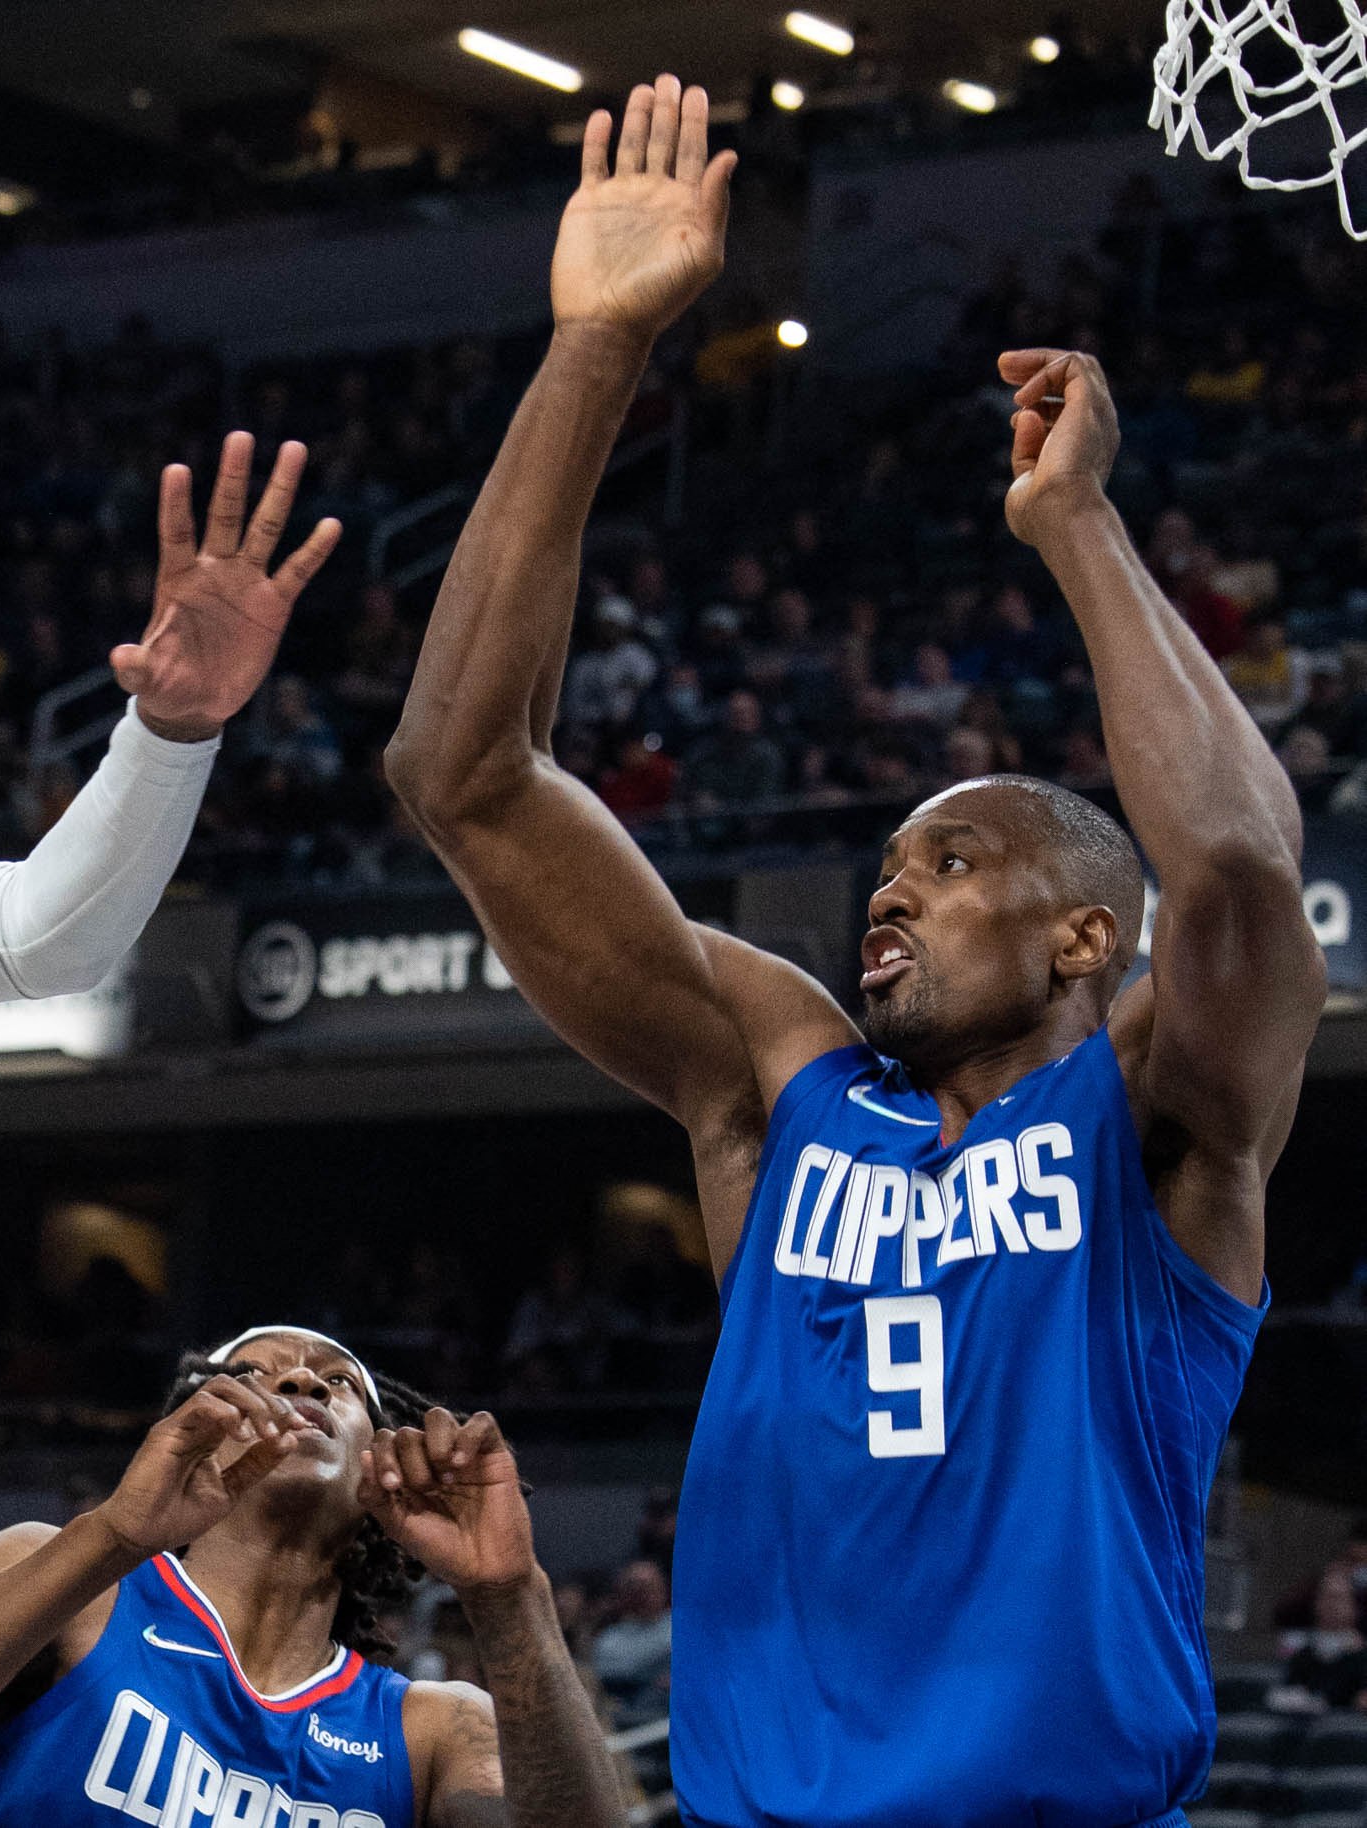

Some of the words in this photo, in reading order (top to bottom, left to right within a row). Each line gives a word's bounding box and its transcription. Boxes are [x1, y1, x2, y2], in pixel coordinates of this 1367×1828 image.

[319, 932, 475, 998] SPORT
[773, 1121, 1083, 1288] CLIPPERS
[864, 1294, 945, 1458] 9
[307, 1712, 383, 1764] honey
